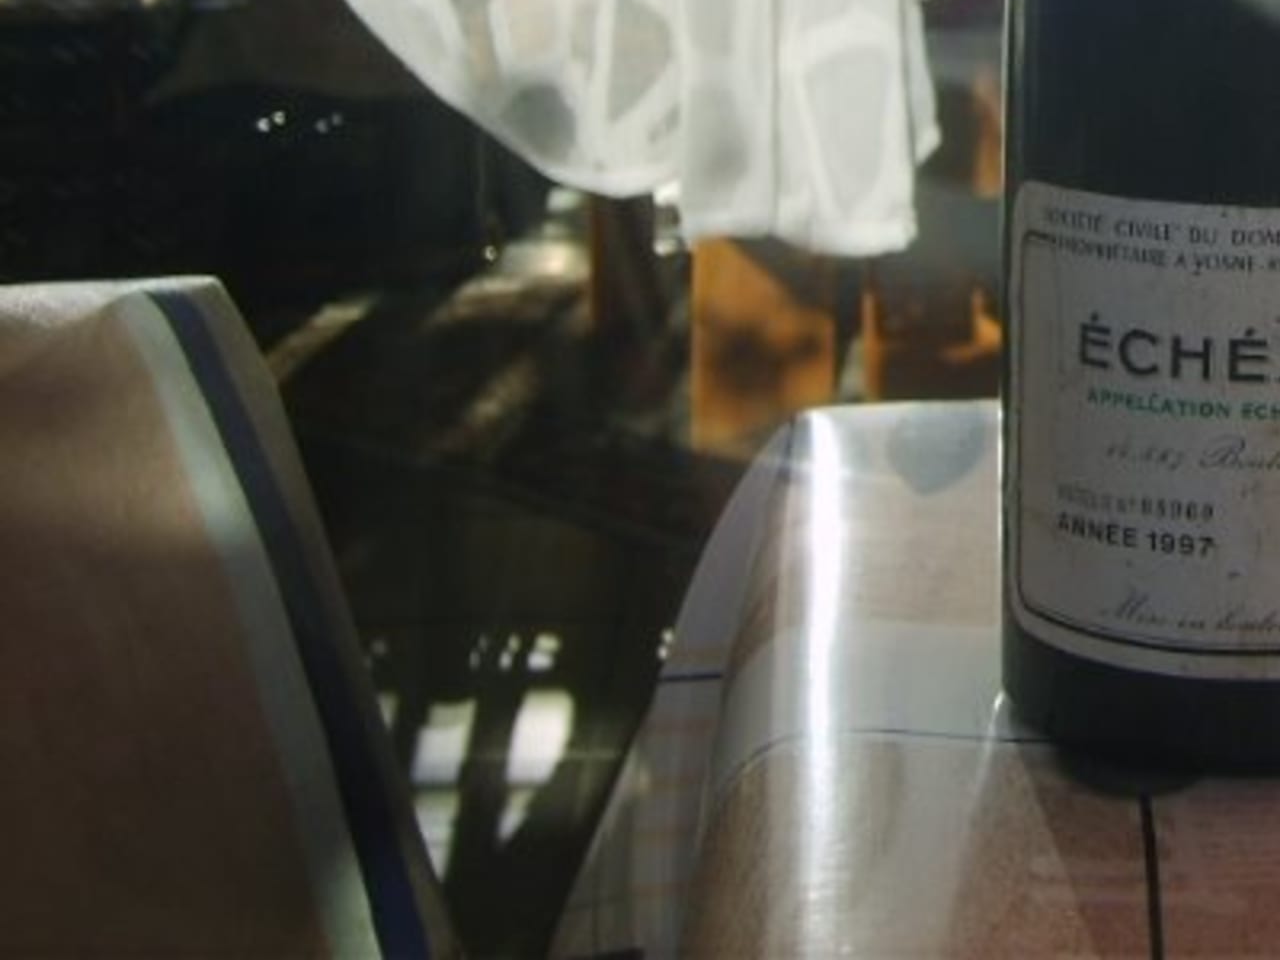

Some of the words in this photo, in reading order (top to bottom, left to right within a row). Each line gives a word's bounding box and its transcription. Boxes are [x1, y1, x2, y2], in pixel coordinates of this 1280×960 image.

[1188, 225, 1217, 246] DU
[1086, 386, 1231, 420] APPELLATION
[1146, 528, 1217, 558] 1997
